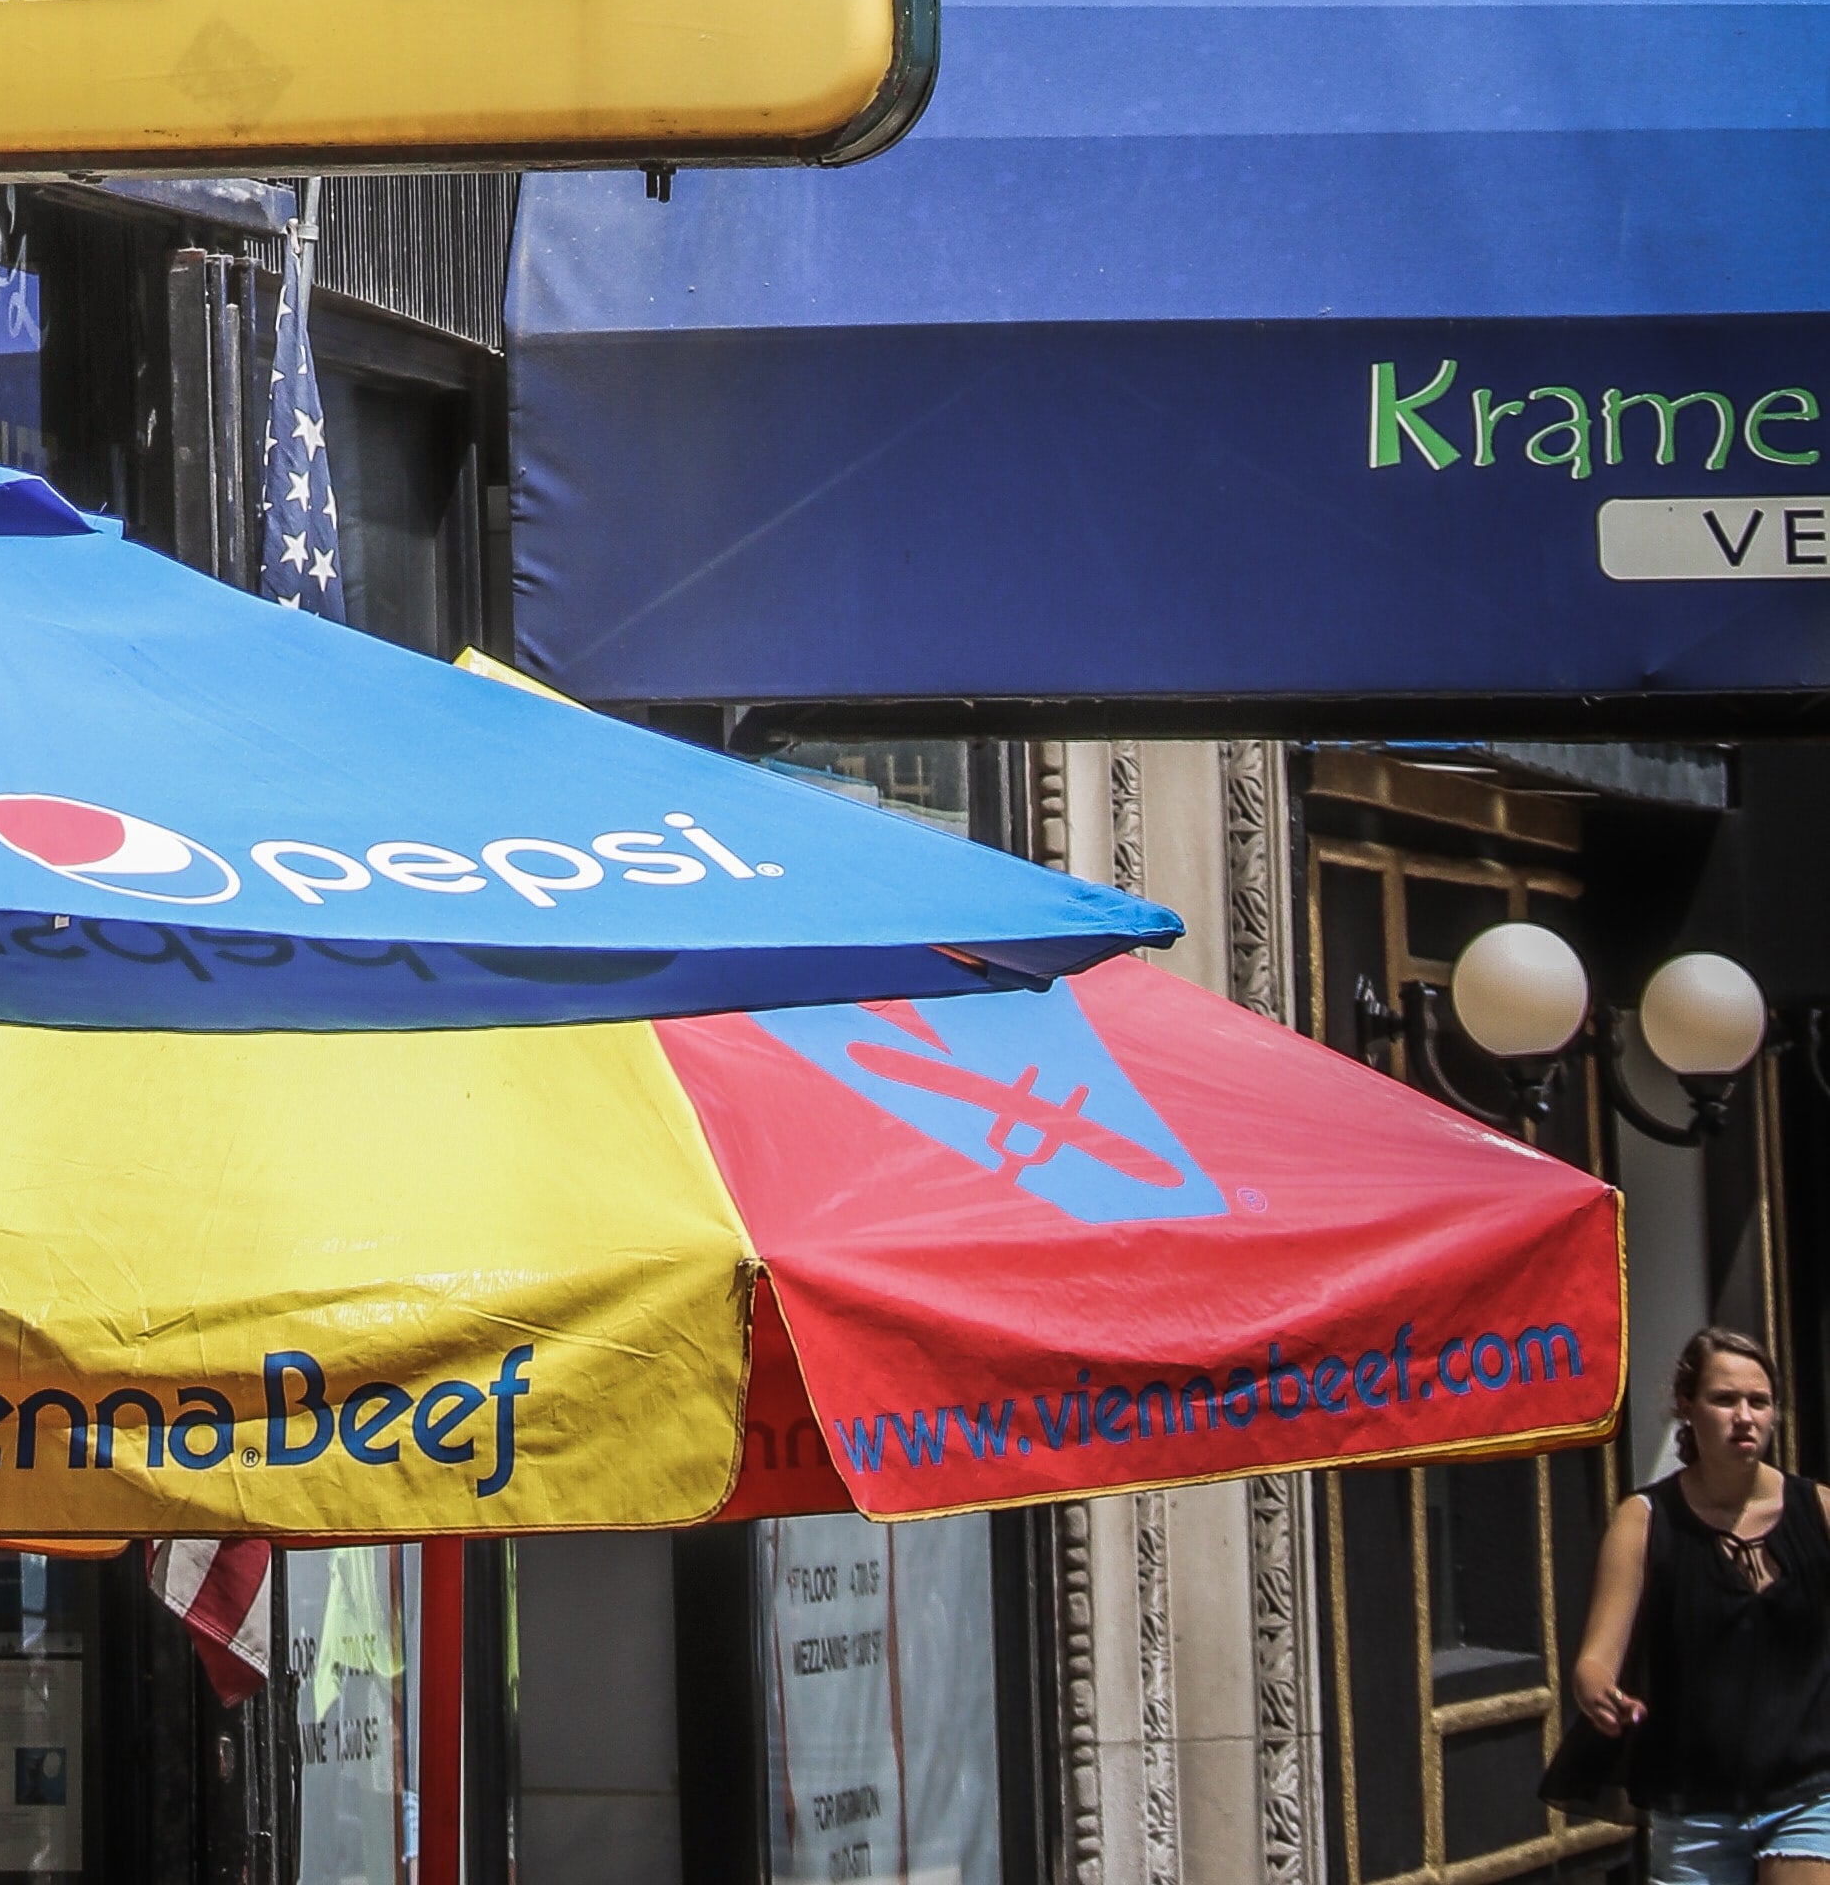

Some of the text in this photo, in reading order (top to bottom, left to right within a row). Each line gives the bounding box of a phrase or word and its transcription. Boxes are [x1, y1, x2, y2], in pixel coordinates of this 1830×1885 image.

[1370, 359, 1820, 479] Krame
[1702, 507, 1827, 568] VE
[263, 1344, 534, 1499] Beef
[833, 1321, 1584, 1476] www.viennabeef.com
